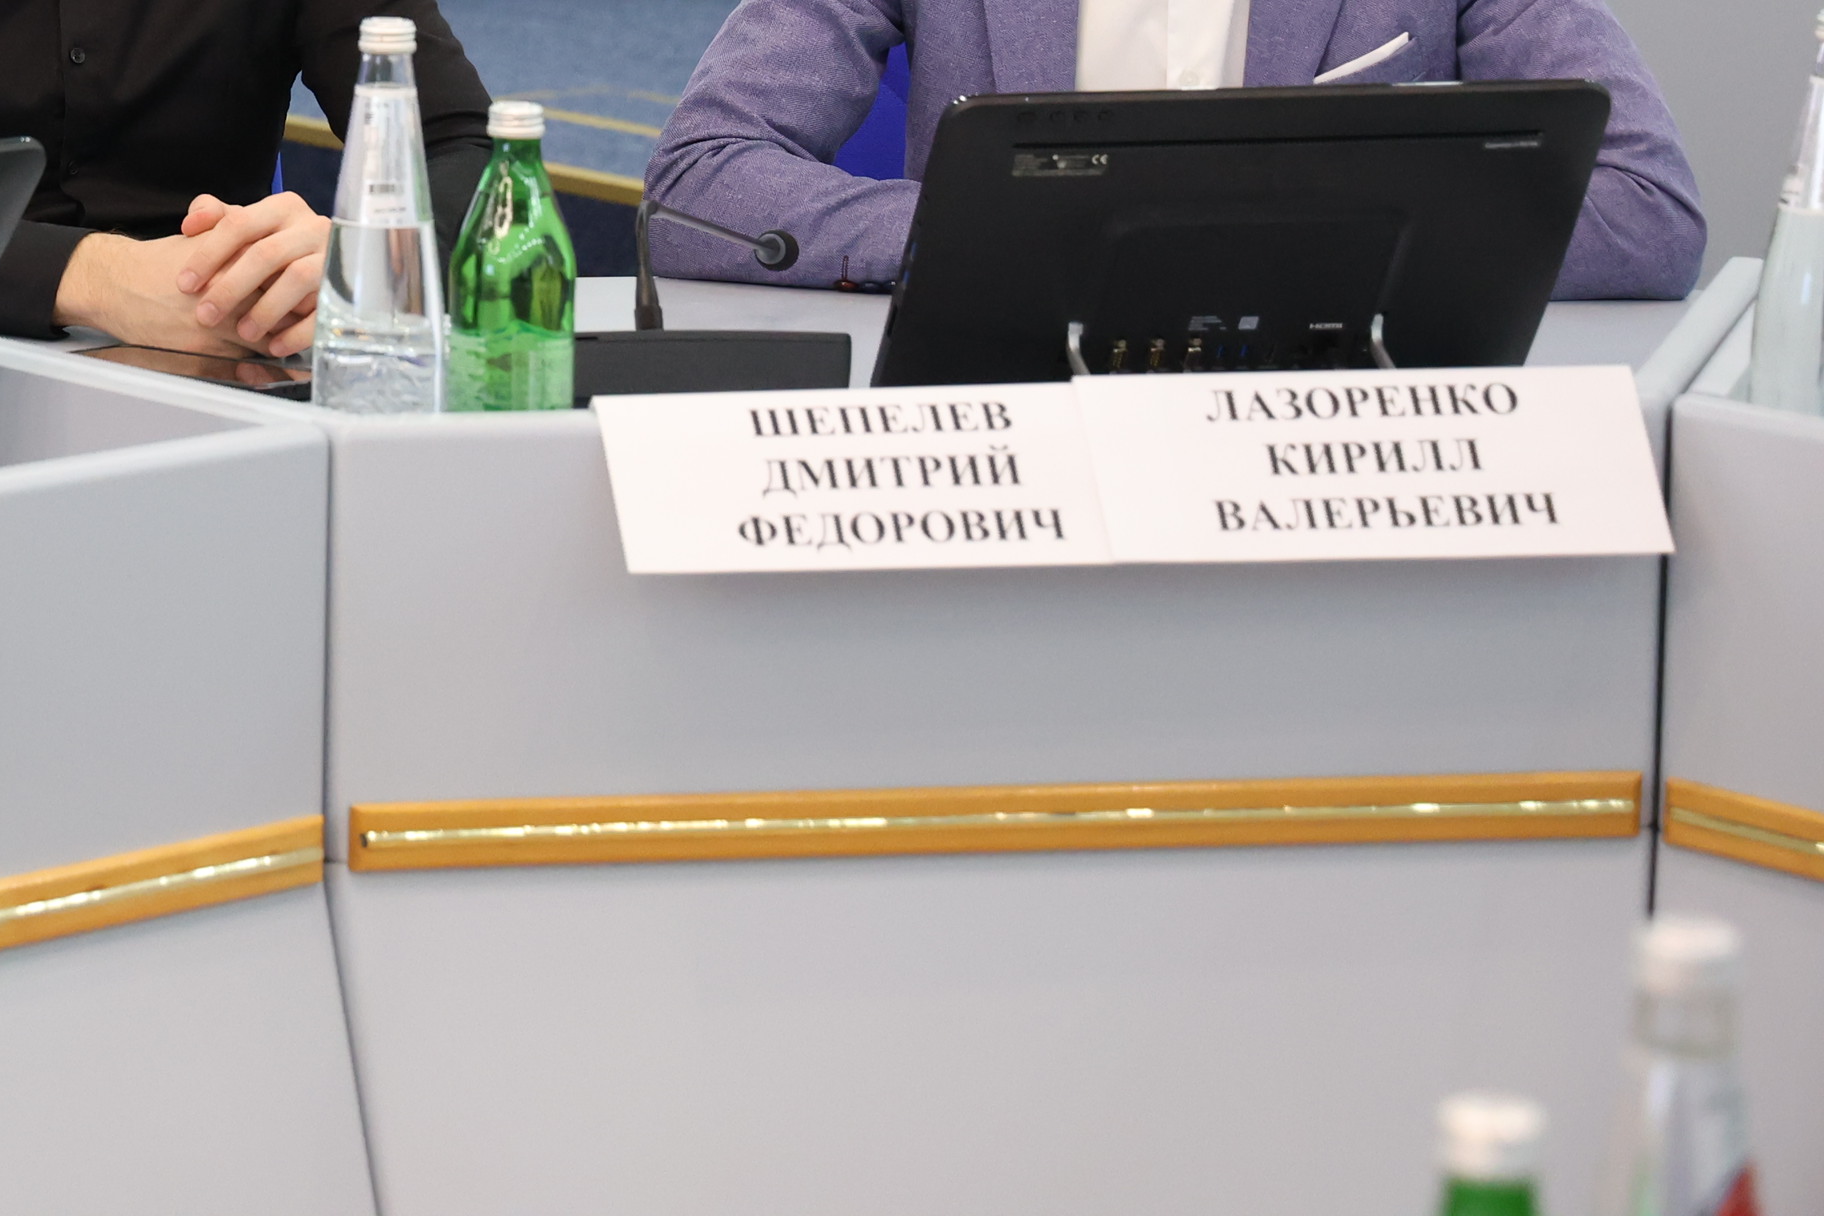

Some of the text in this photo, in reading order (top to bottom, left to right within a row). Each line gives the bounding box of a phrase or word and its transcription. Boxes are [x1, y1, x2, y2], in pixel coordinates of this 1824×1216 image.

[748, 400, 1014, 438] ШЕПЕЛЕВ
[1205, 381, 1520, 423] ЛАЗОРЕНКО
[762, 444, 1023, 498] ДМИТРИЙ
[1263, 437, 1486, 476] КИРИЛЛ
[737, 506, 1067, 553] ФЕДОРОВИЧ
[1212, 491, 1562, 533] ВАЛЕРЬЕВИЧ
